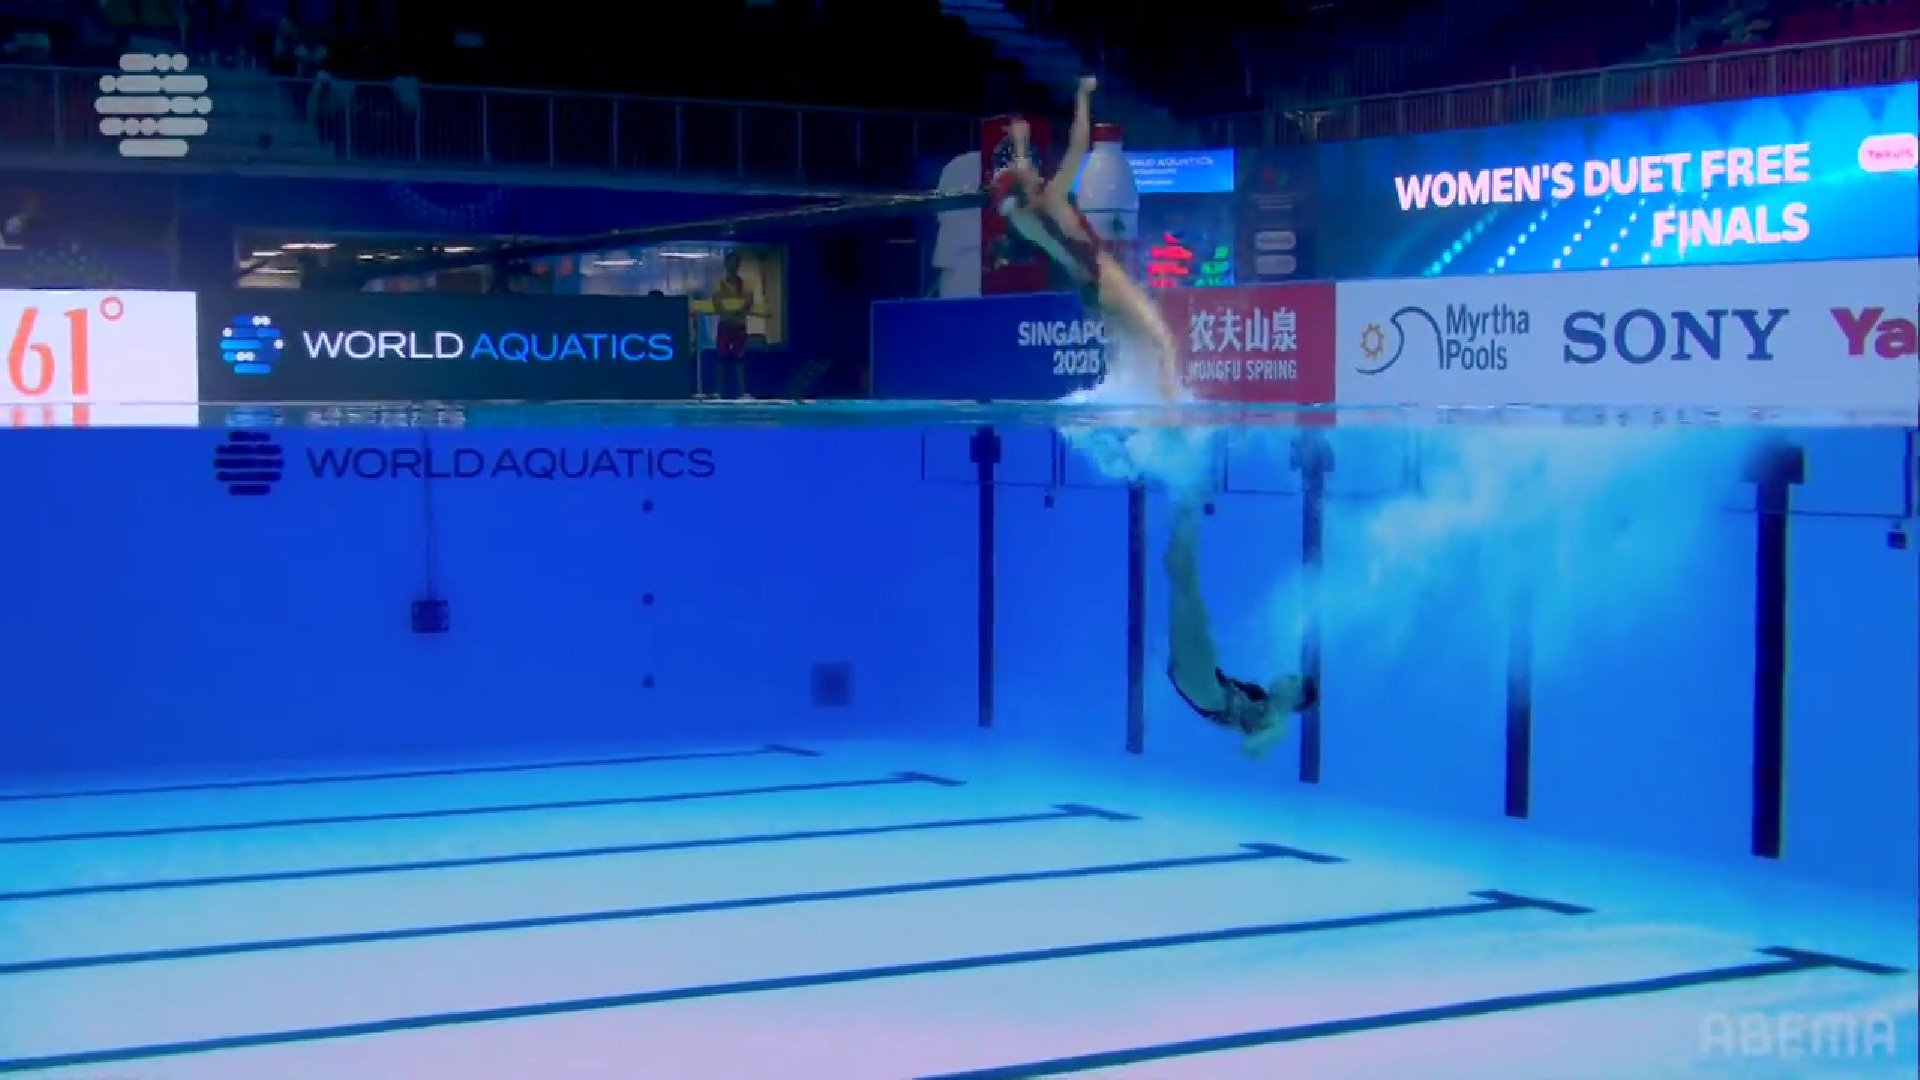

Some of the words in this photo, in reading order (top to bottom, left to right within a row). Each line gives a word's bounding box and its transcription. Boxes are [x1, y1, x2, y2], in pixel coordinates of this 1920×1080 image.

[1395, 162, 1574, 211] WOMEN'S
[1584, 153, 1691, 197] DUET
[1701, 143, 1810, 187] FREE
[1652, 203, 1810, 250] FINALS
[1017, 320, 1109, 346] SINGAPO
[1190, 306, 1298, 352] 农夫山泉
[1446, 303, 1530, 336] Myrtha
[1562, 308, 1789, 364] SONY
[302, 331, 465, 359] WORLD
[470, 333, 675, 362] AQUATICS
[1053, 349, 1101, 375] 2025
[1446, 340, 1508, 369] Pools
[1245, 360, 1298, 380] SPRING
[306, 447, 485, 479] WORLD
[490, 447, 717, 480] AQUATICS
